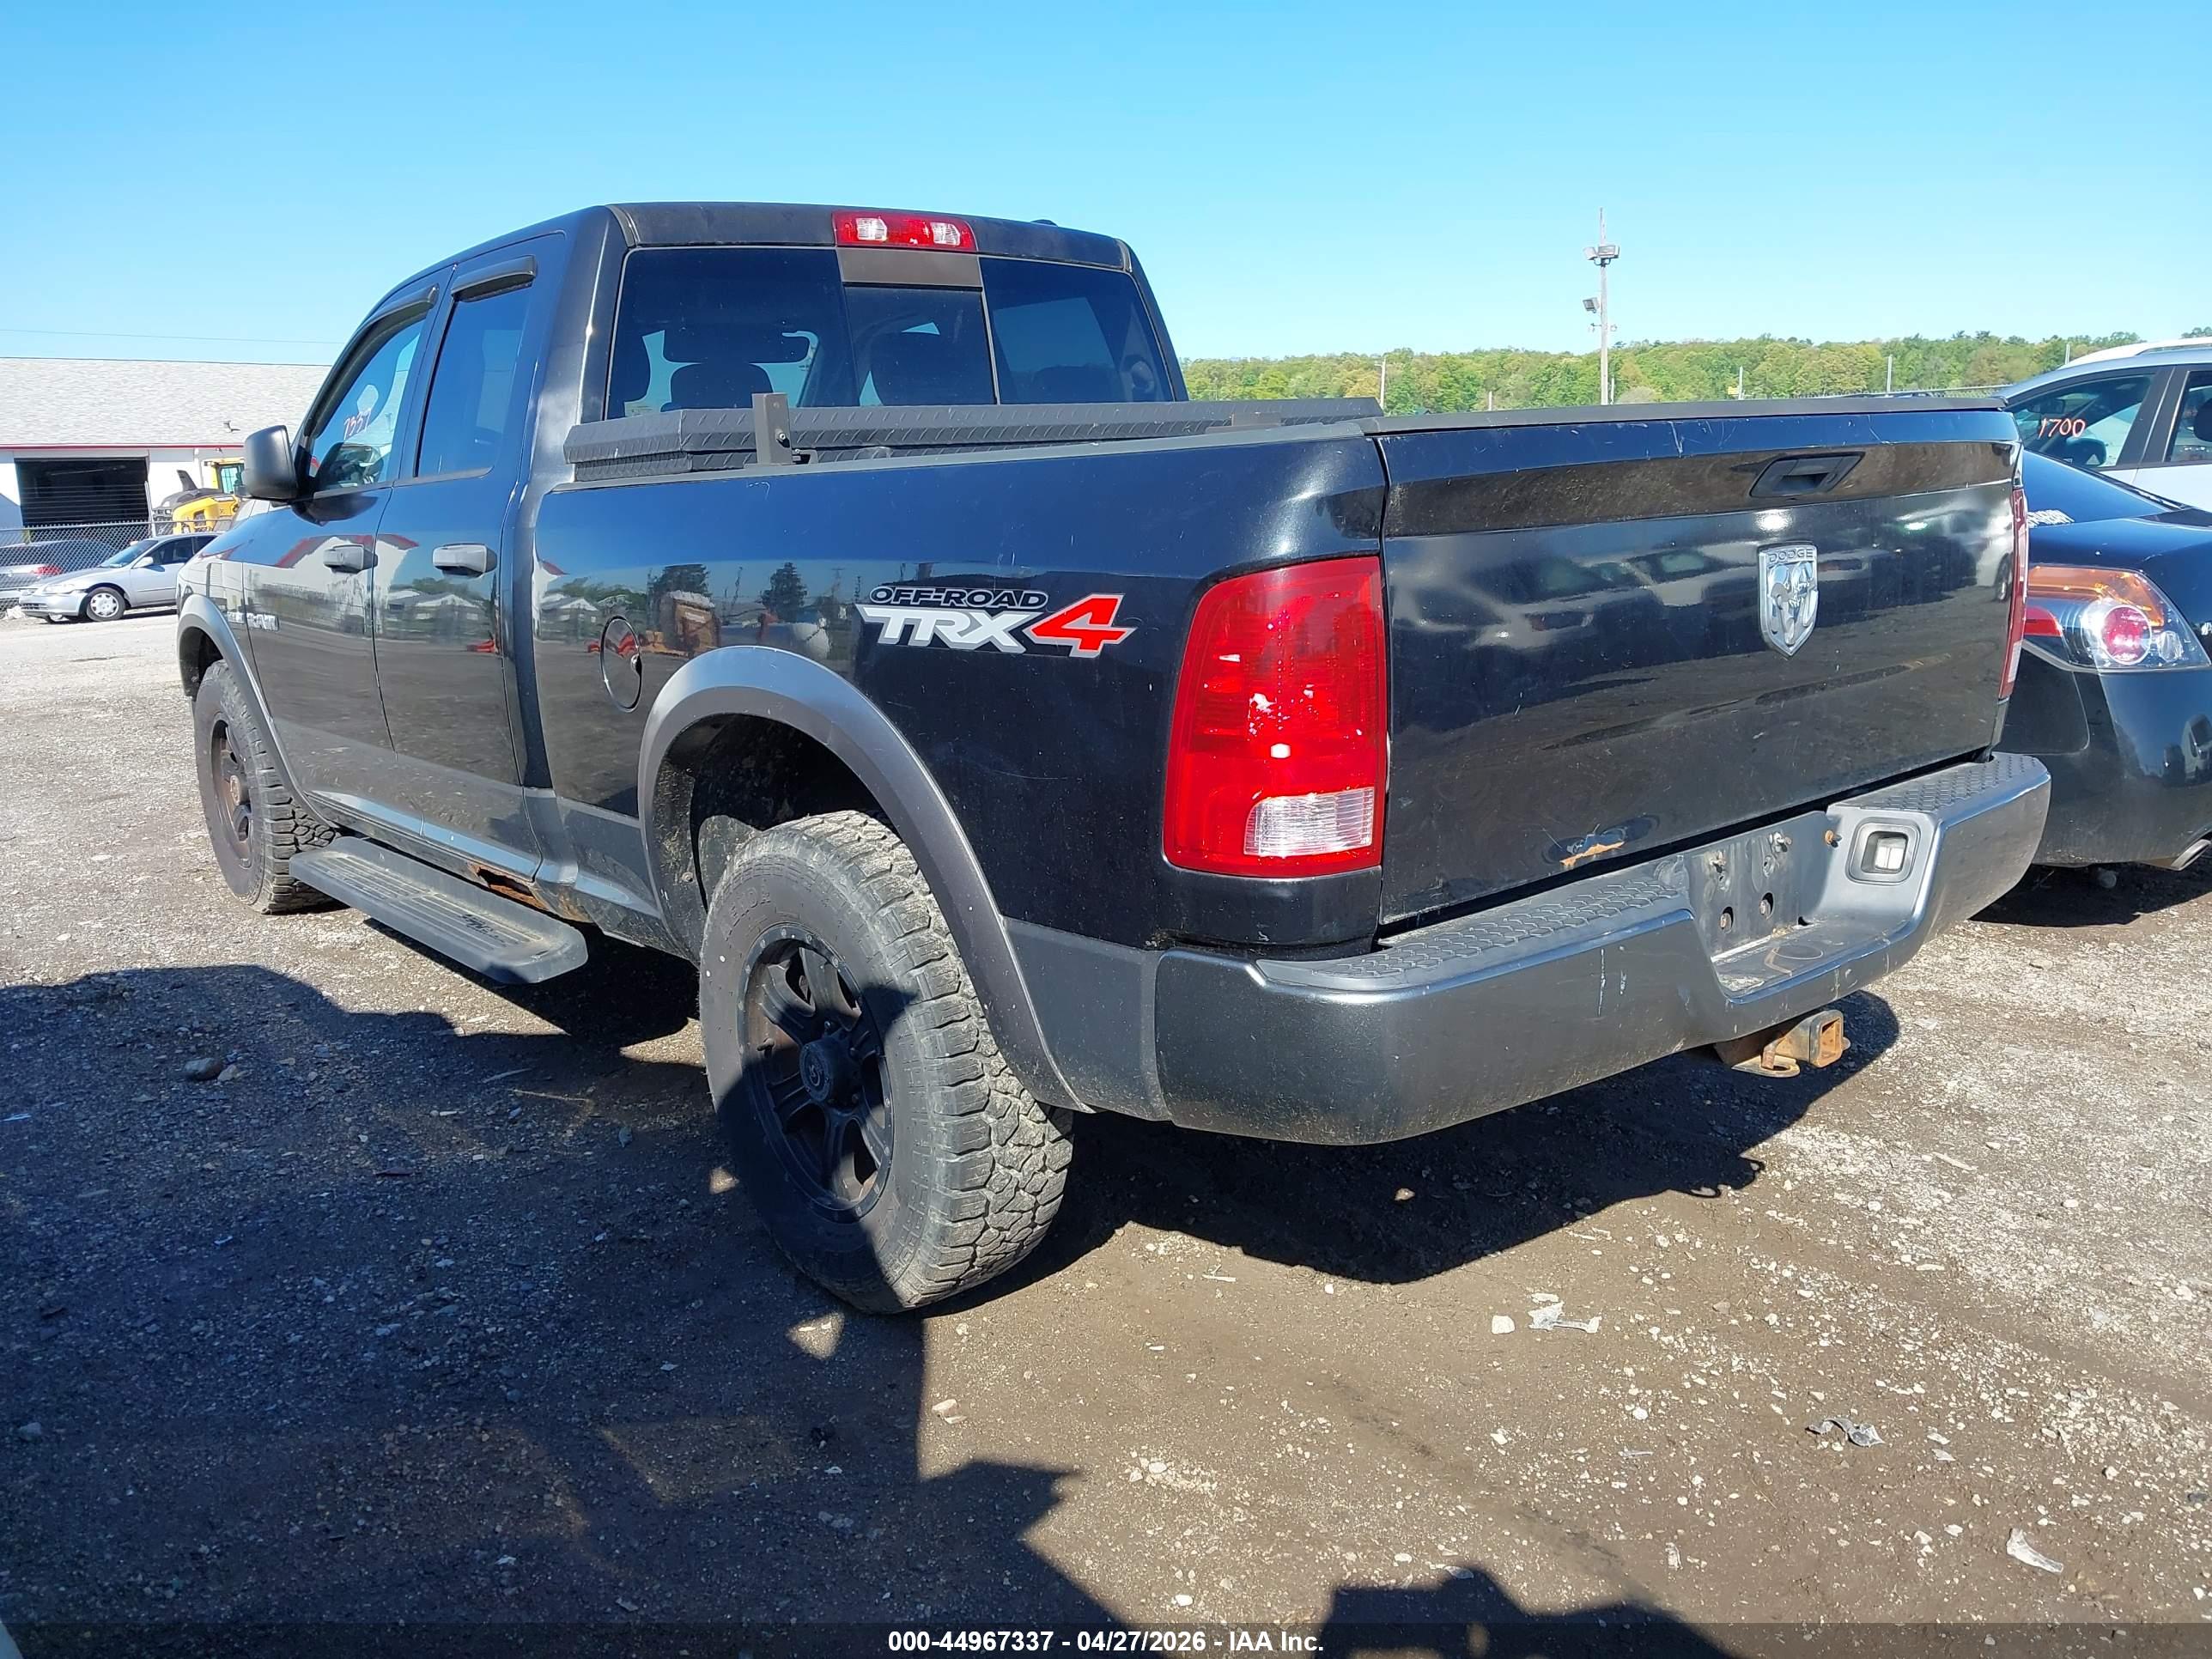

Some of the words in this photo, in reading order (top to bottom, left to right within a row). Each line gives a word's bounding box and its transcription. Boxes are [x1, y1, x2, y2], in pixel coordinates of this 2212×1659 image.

[2038, 417, 2086, 440] 1700
[1769, 548, 1814, 563] DODGE
[869, 586, 1048, 609] OFF-ROAD
